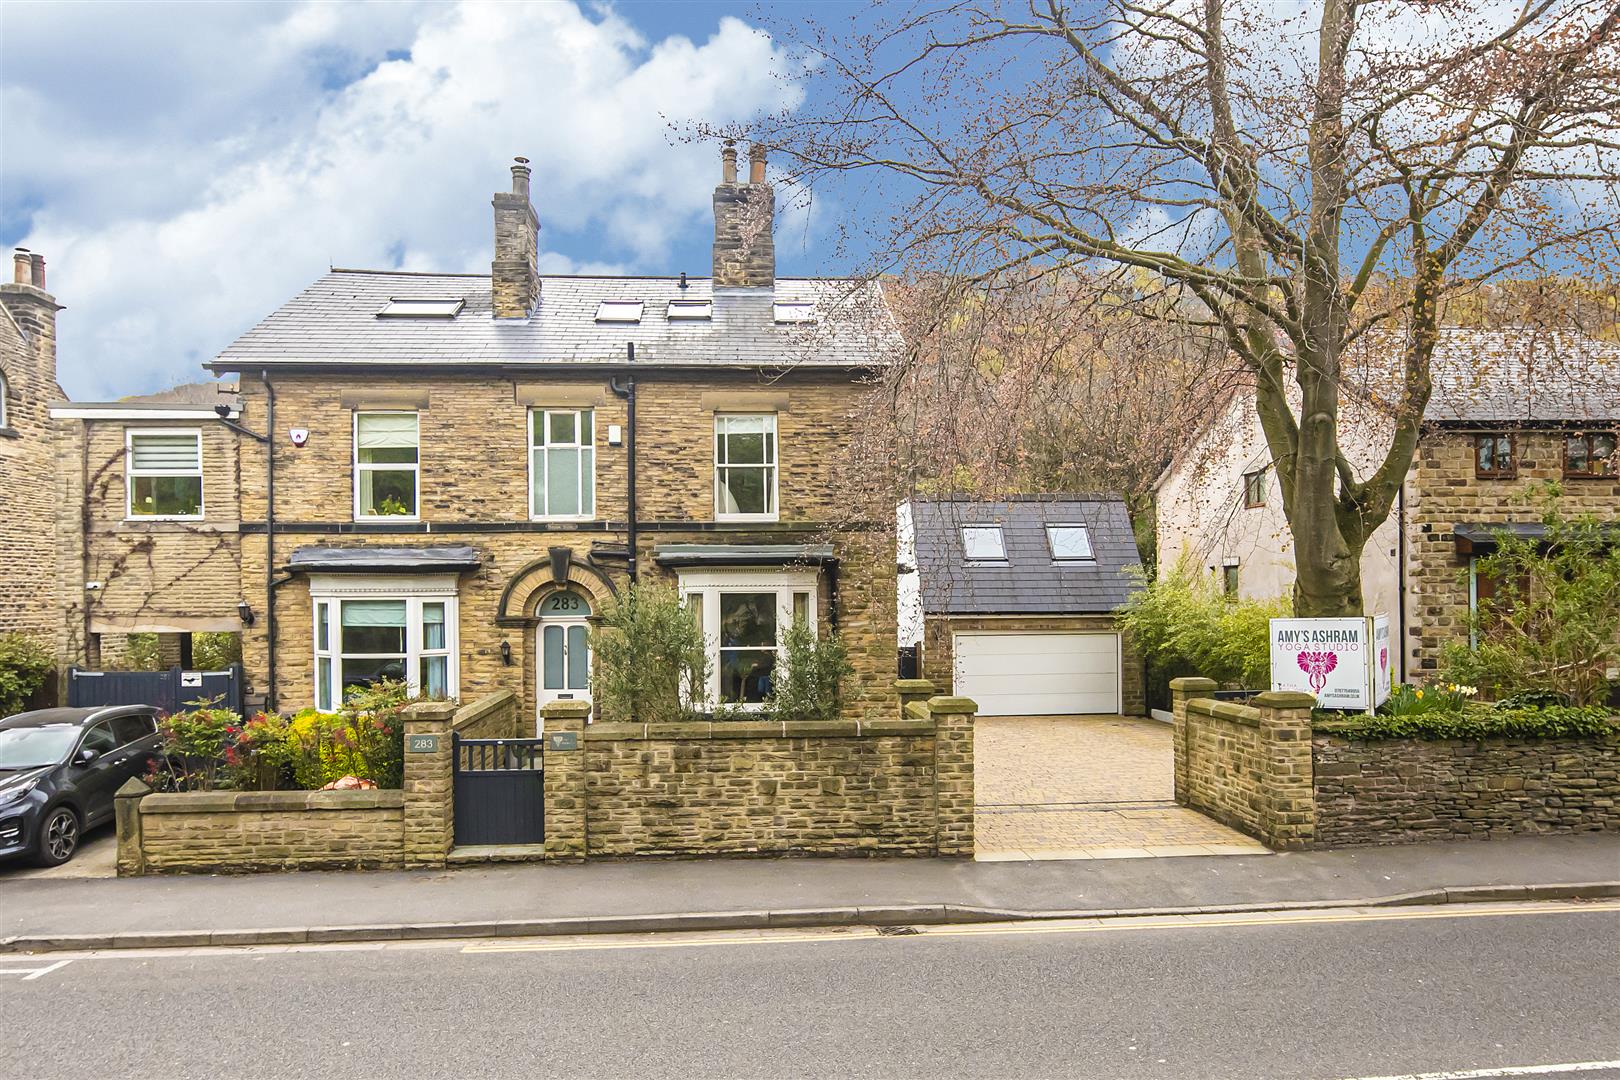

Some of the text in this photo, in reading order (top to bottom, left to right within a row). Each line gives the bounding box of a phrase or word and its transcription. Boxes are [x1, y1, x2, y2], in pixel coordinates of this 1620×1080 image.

[552, 597, 579, 610] 283
[1278, 630, 1358, 643] AMY'S ASHRAM
[1278, 643, 1359, 651] YOGA STUDIO
[414, 739, 433, 749] 283
